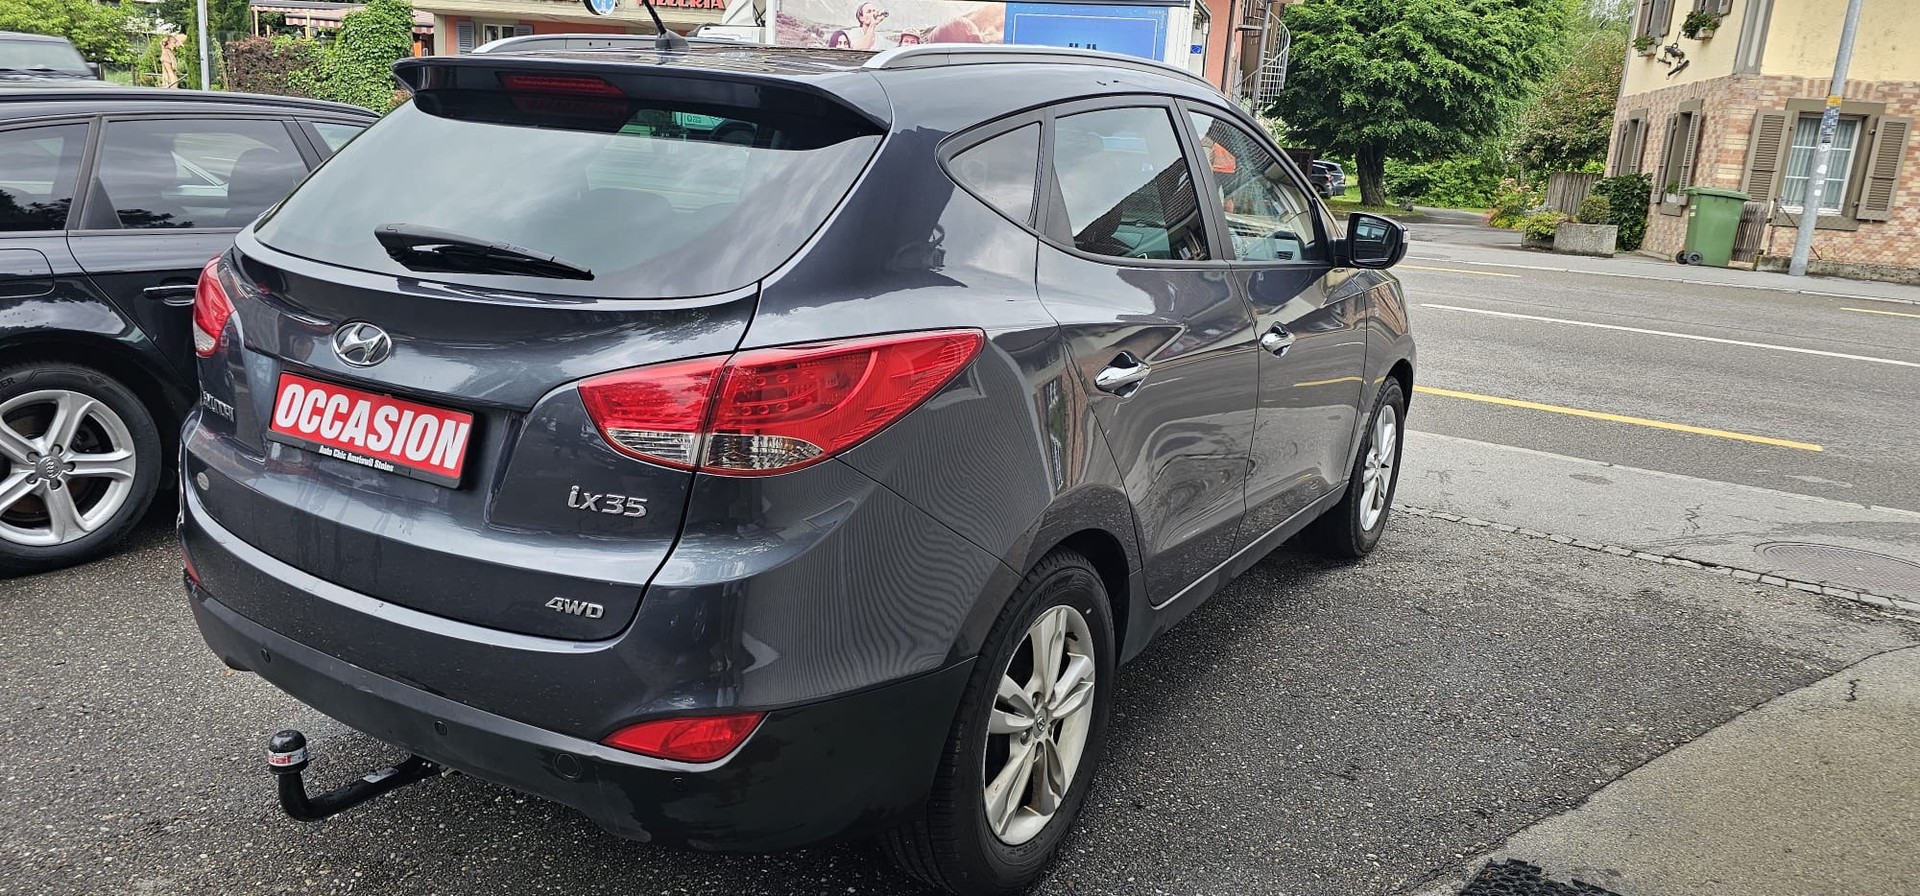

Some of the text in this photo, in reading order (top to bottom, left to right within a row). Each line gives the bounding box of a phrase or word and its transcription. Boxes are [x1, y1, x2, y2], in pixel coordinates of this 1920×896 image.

[637, 0, 726, 9] ZZERIA
[275, 383, 470, 470] OCCASION
[319, 445, 333, 456] Auto
[567, 485, 648, 518] ix35
[544, 596, 604, 619] 4WD
